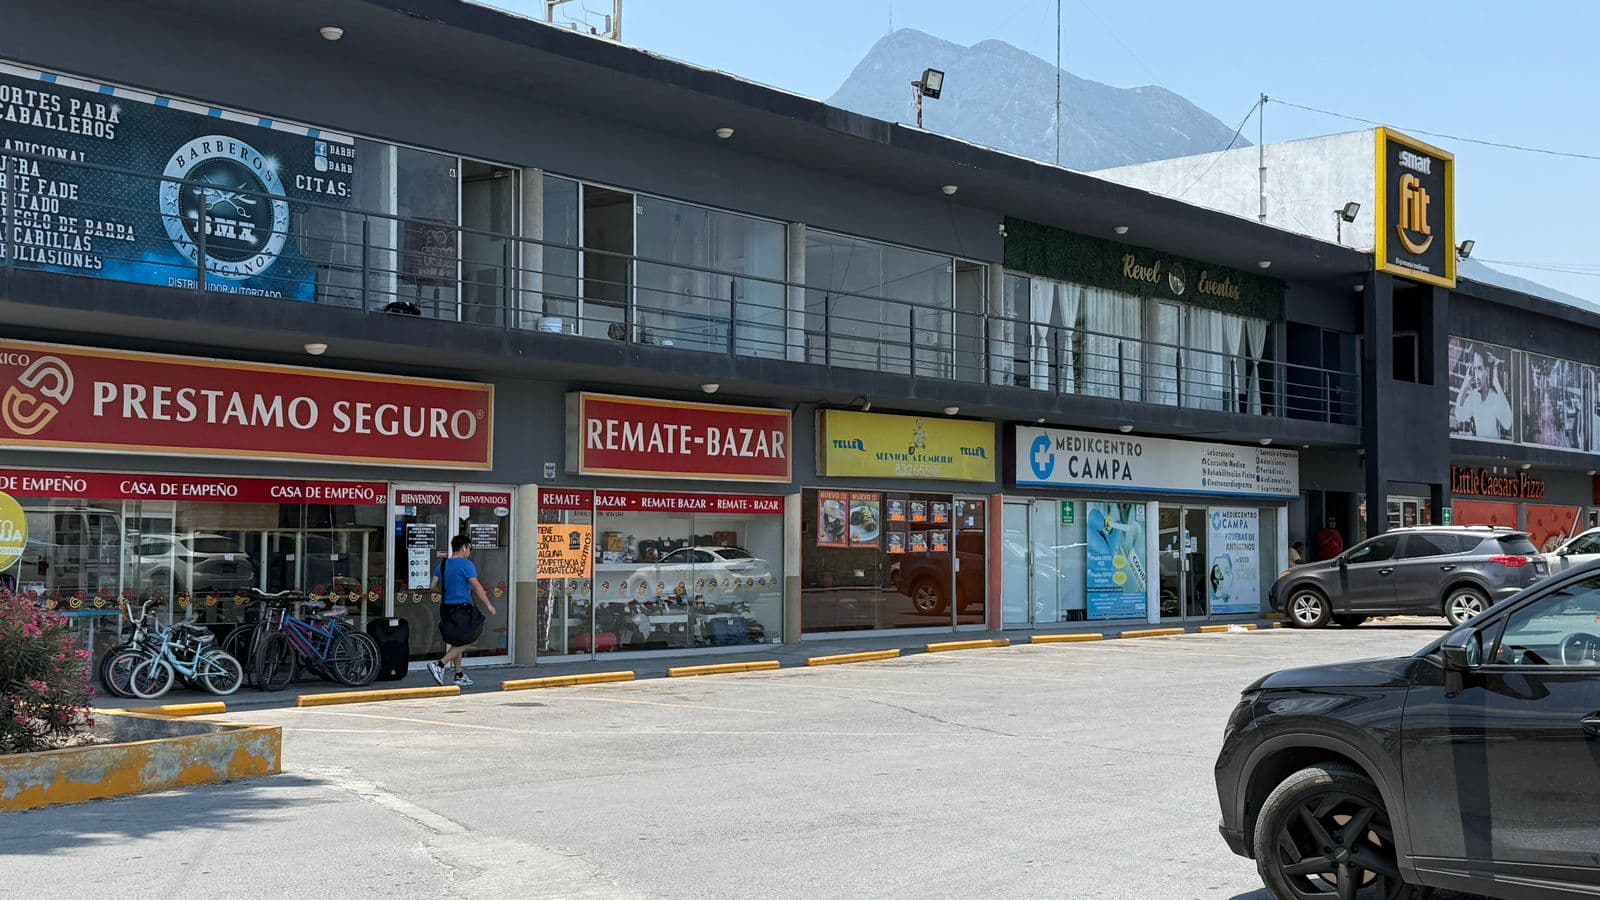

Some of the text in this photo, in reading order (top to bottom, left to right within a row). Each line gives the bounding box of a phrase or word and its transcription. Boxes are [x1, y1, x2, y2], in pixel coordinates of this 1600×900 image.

[70, 98, 120, 124] PARA
[176, 141, 273, 182] BARBEROS
[1399, 150, 1431, 174] smart
[38, 178, 79, 200] FADE
[296, 174, 351, 198] CITAS:
[1399, 173, 1431, 235] fit
[59, 216, 77, 233] DE
[85, 219, 135, 241] BARBA
[174, 234, 273, 277] MEICANOS
[1122, 253, 1240, 300] Revel Eventos
[93, 381, 477, 440] PRESTAMO SEGURO
[587, 418, 785, 459] REMATE-BAZAR
[1056, 436, 1142, 456] MEDIKCENTRO
[1068, 455, 1132, 480] CAMPA
[0, 475, 87, 492] DE EMPEÑO
[120, 480, 238, 497] CASA DE EMPEÑO
[270, 485, 374, 499] CASA DE EMPEÑO
[1451, 465, 1545, 499] Little Caesars Pizza
[401, 493, 442, 505] BIENVENIDOS
[461, 495, 507, 505] BIENVENIDOS
[543, 493, 580, 505] REMATE
[595, 496, 627, 507] BAZAR
[641, 497, 675, 508] REMATE
[678, 498, 706, 509] BAZAR
[717, 499, 747, 509] REMATE
[753, 500, 779, 511] BAZAR
[1222, 511, 1257, 519] MEDIKCENTRO
[1222, 519, 1248, 529] CAMPA
[542, 534, 564, 543] BOLETA
